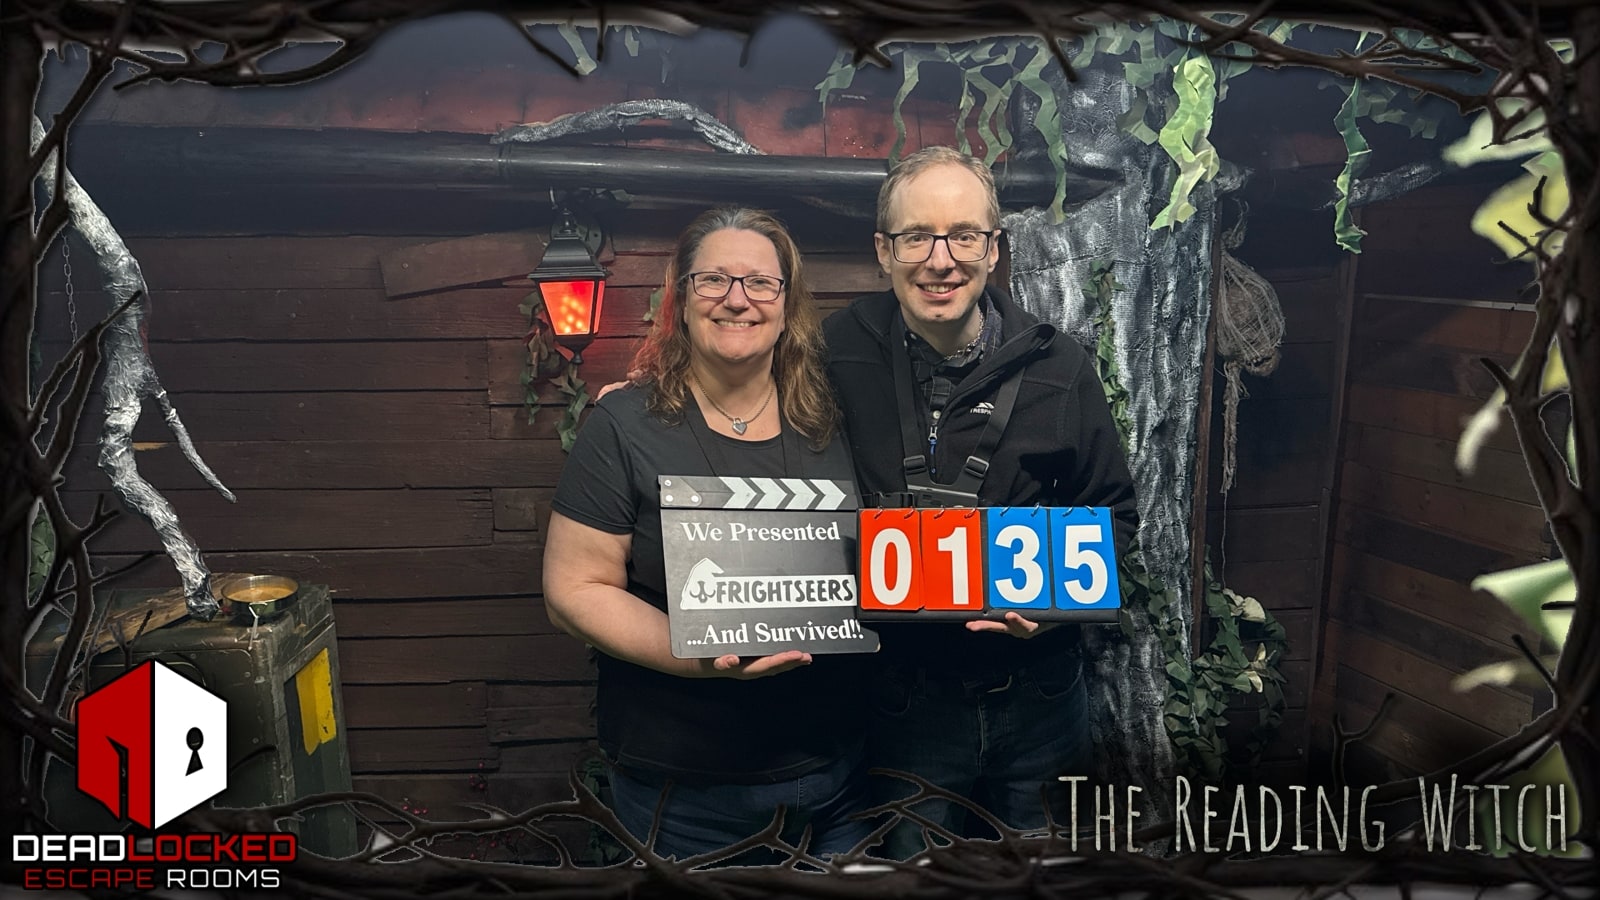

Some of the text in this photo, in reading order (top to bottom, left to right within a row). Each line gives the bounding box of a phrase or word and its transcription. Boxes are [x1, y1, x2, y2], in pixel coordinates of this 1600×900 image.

[680, 521, 841, 541] We Presented
[716, 578, 853, 604] FRIGHTSEERS
[754, 619, 864, 643] Survived!!
